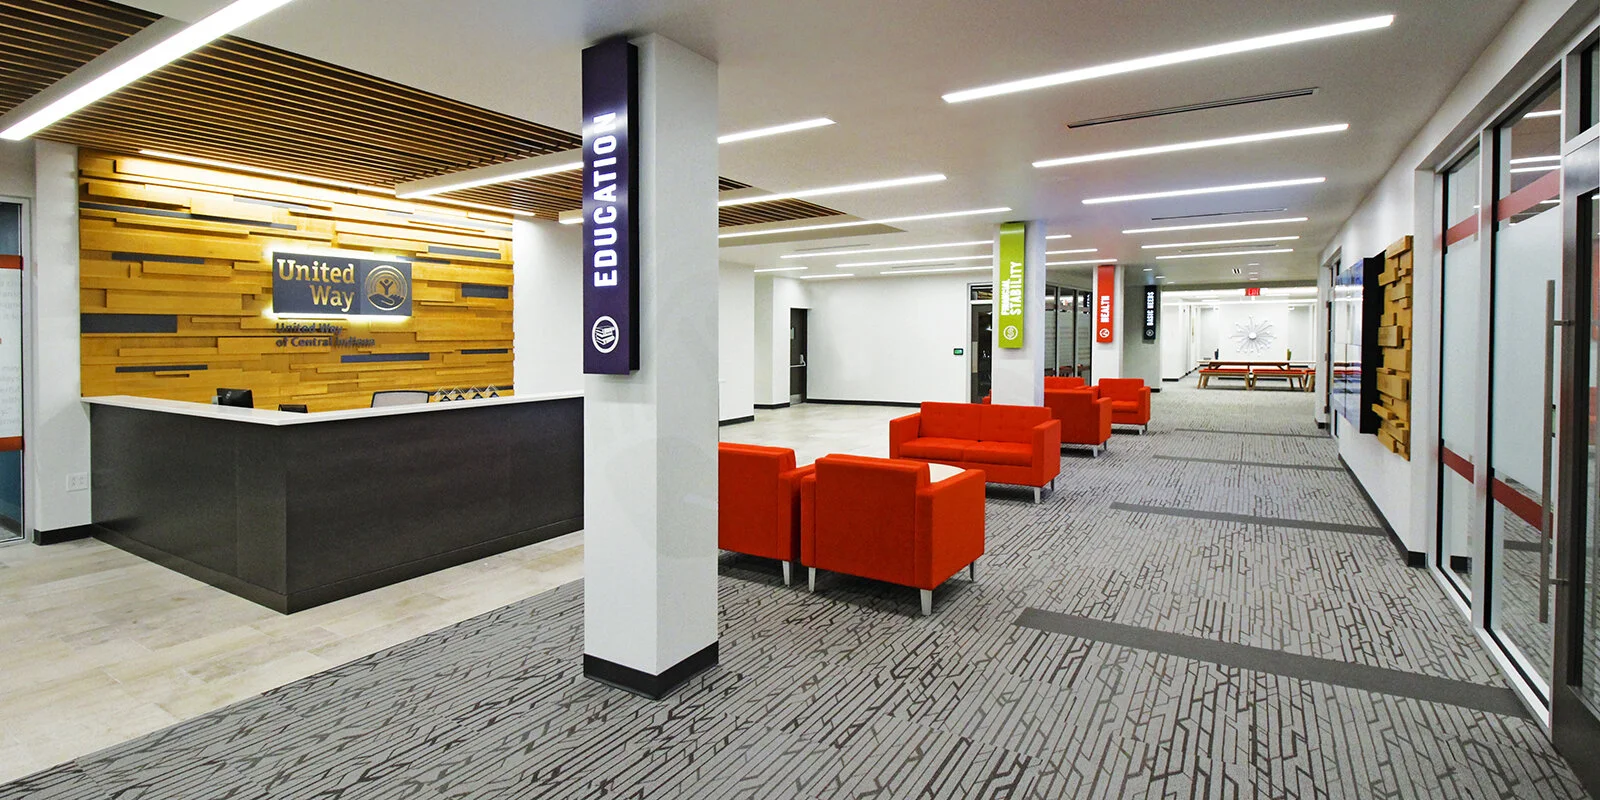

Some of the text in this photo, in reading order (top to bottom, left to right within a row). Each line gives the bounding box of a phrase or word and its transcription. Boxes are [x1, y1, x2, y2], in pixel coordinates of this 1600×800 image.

[593, 111, 618, 287] EDUCATION
[276, 258, 356, 284] United
[309, 284, 355, 312] Way
[1010, 261, 1022, 316] STABILITY
[1100, 295, 1111, 323] HEALTH
[275, 322, 343, 335] United Way
[275, 336, 376, 348] of Central Indiana
